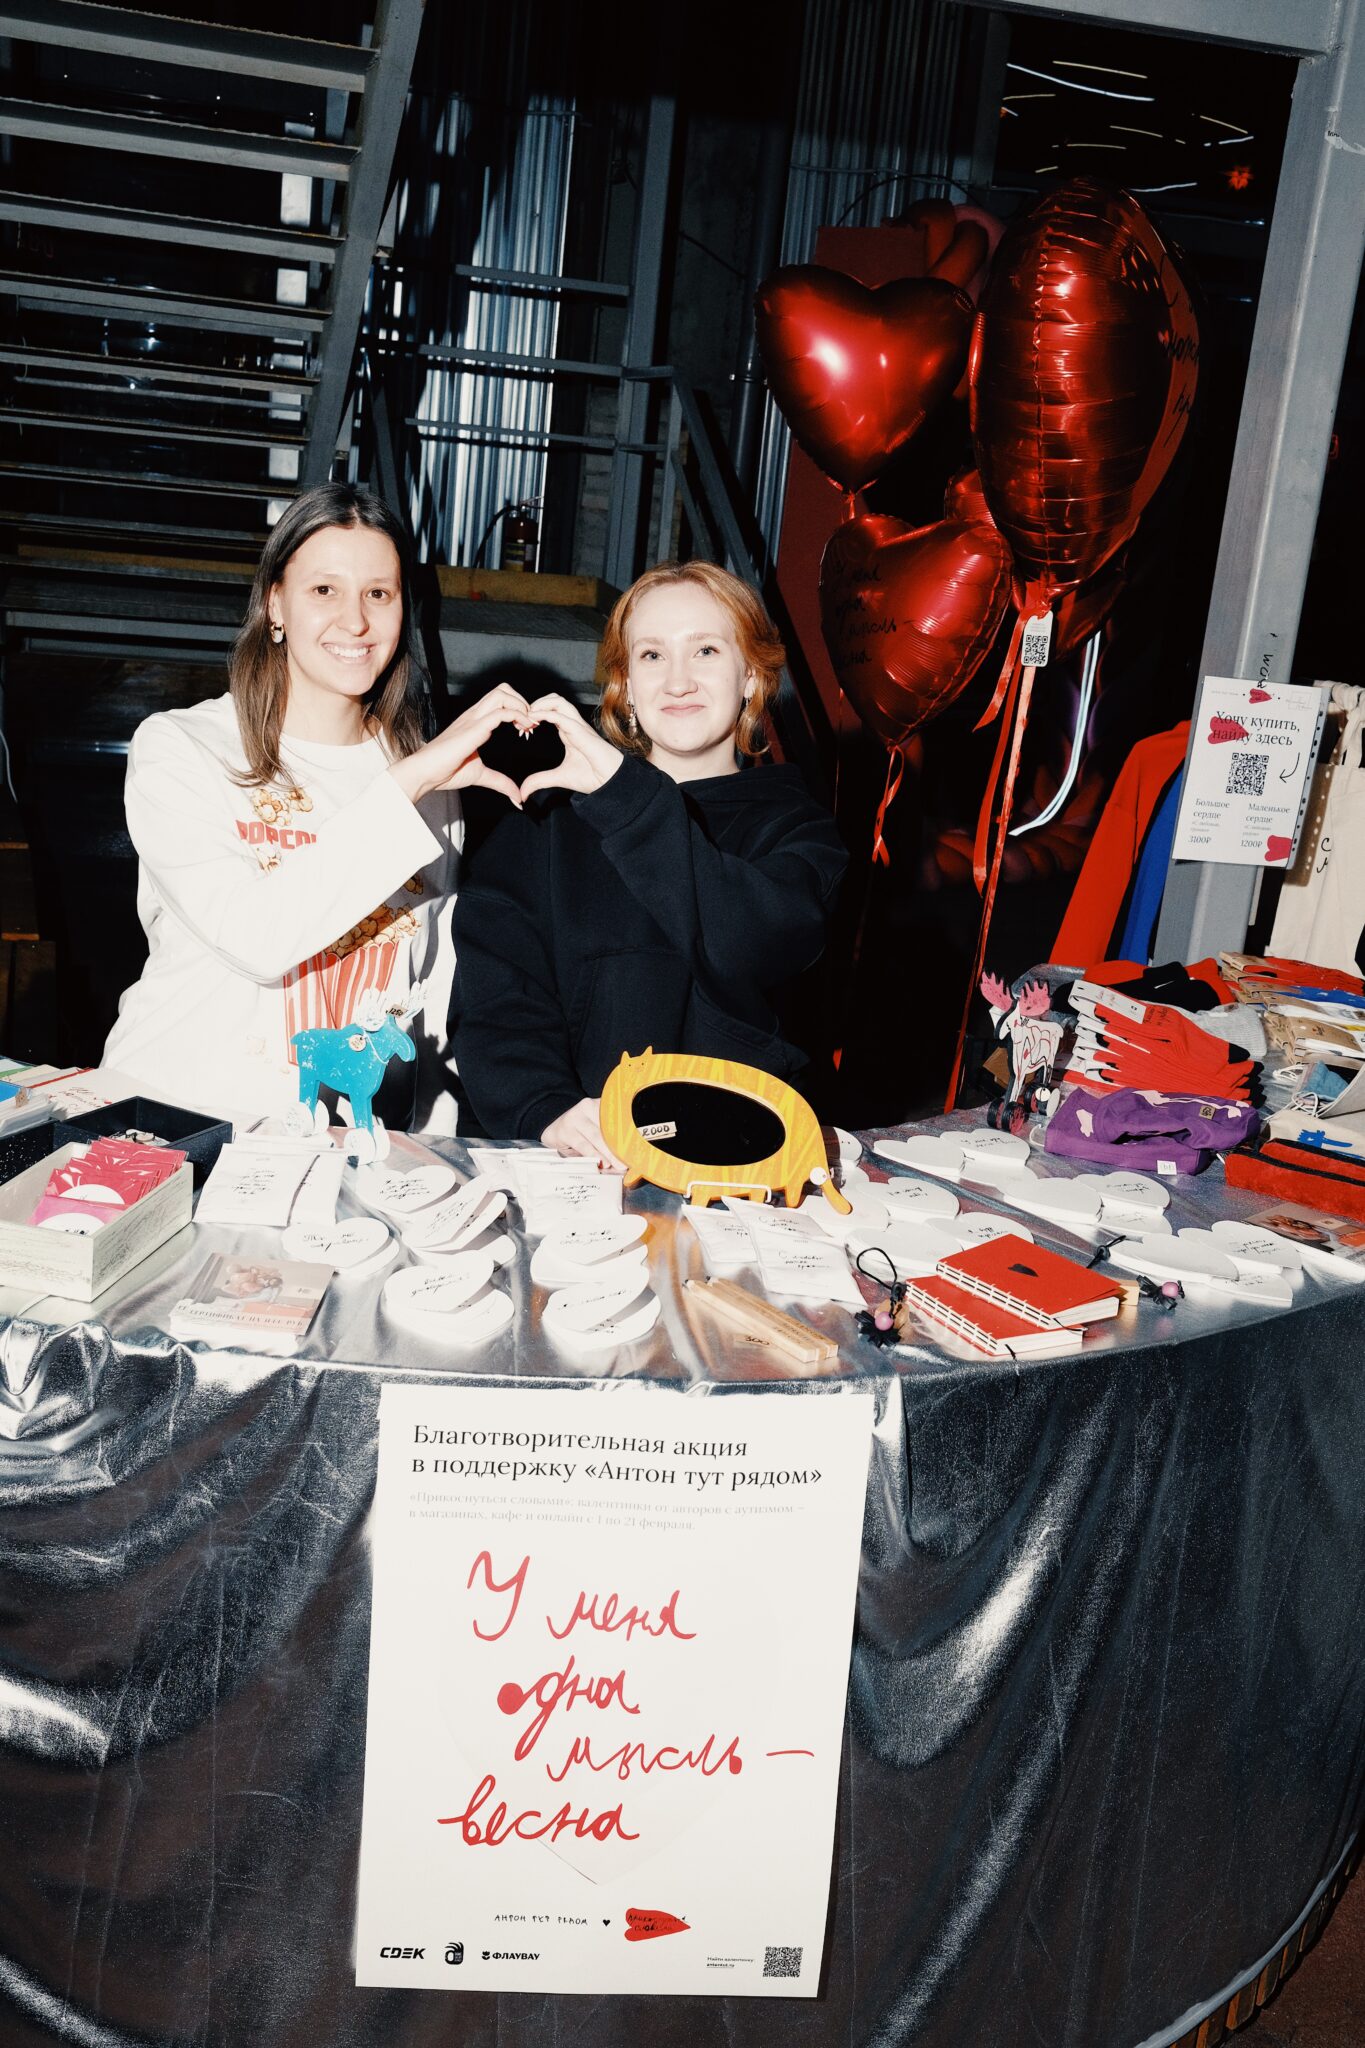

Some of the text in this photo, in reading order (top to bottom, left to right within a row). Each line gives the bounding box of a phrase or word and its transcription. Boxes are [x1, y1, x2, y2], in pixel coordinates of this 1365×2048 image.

[1215, 710, 1301, 733] Хочу купить,
[1212, 728, 1294, 746] найду здесь
[1195, 798, 1230, 809] Большое
[1248, 803, 1292, 814] Маленькое
[1192, 811, 1222, 820] сердце
[1245, 815, 1274, 824] сердце
[641, 1124, 671, 1137] 2000
[414, 1425, 748, 1460] Благотворительная акция
[412, 1459, 822, 1491] в поддержку «Антон тут рядом»
[410, 1492, 507, 1509] «Прикоснуться
[577, 1498, 651, 1512] валентинки
[654, 1502, 669, 1513] от
[672, 1503, 722, 1517] авторов
[724, 1506, 731, 1515] с
[734, 1505, 793, 1517] аутизмом
[409, 1510, 417, 1519] в
[491, 1509, 522, 1523] кафе
[526, 1512, 534, 1521] и
[536, 1511, 583, 1524] онлайн
[586, 1515, 594, 1524] с
[606, 1516, 621, 1526] по
[624, 1516, 636, 1527] 21
[639, 1517, 696, 1533] февраля.
[467, 1551, 697, 1641] У меня
[497, 1654, 641, 1761] одна
[546, 1734, 743, 1782] мысль
[437, 1774, 640, 1846] весна
[379, 1947, 426, 1960] CDEK
[492, 1951, 541, 1961] ФЛАУВАУ
